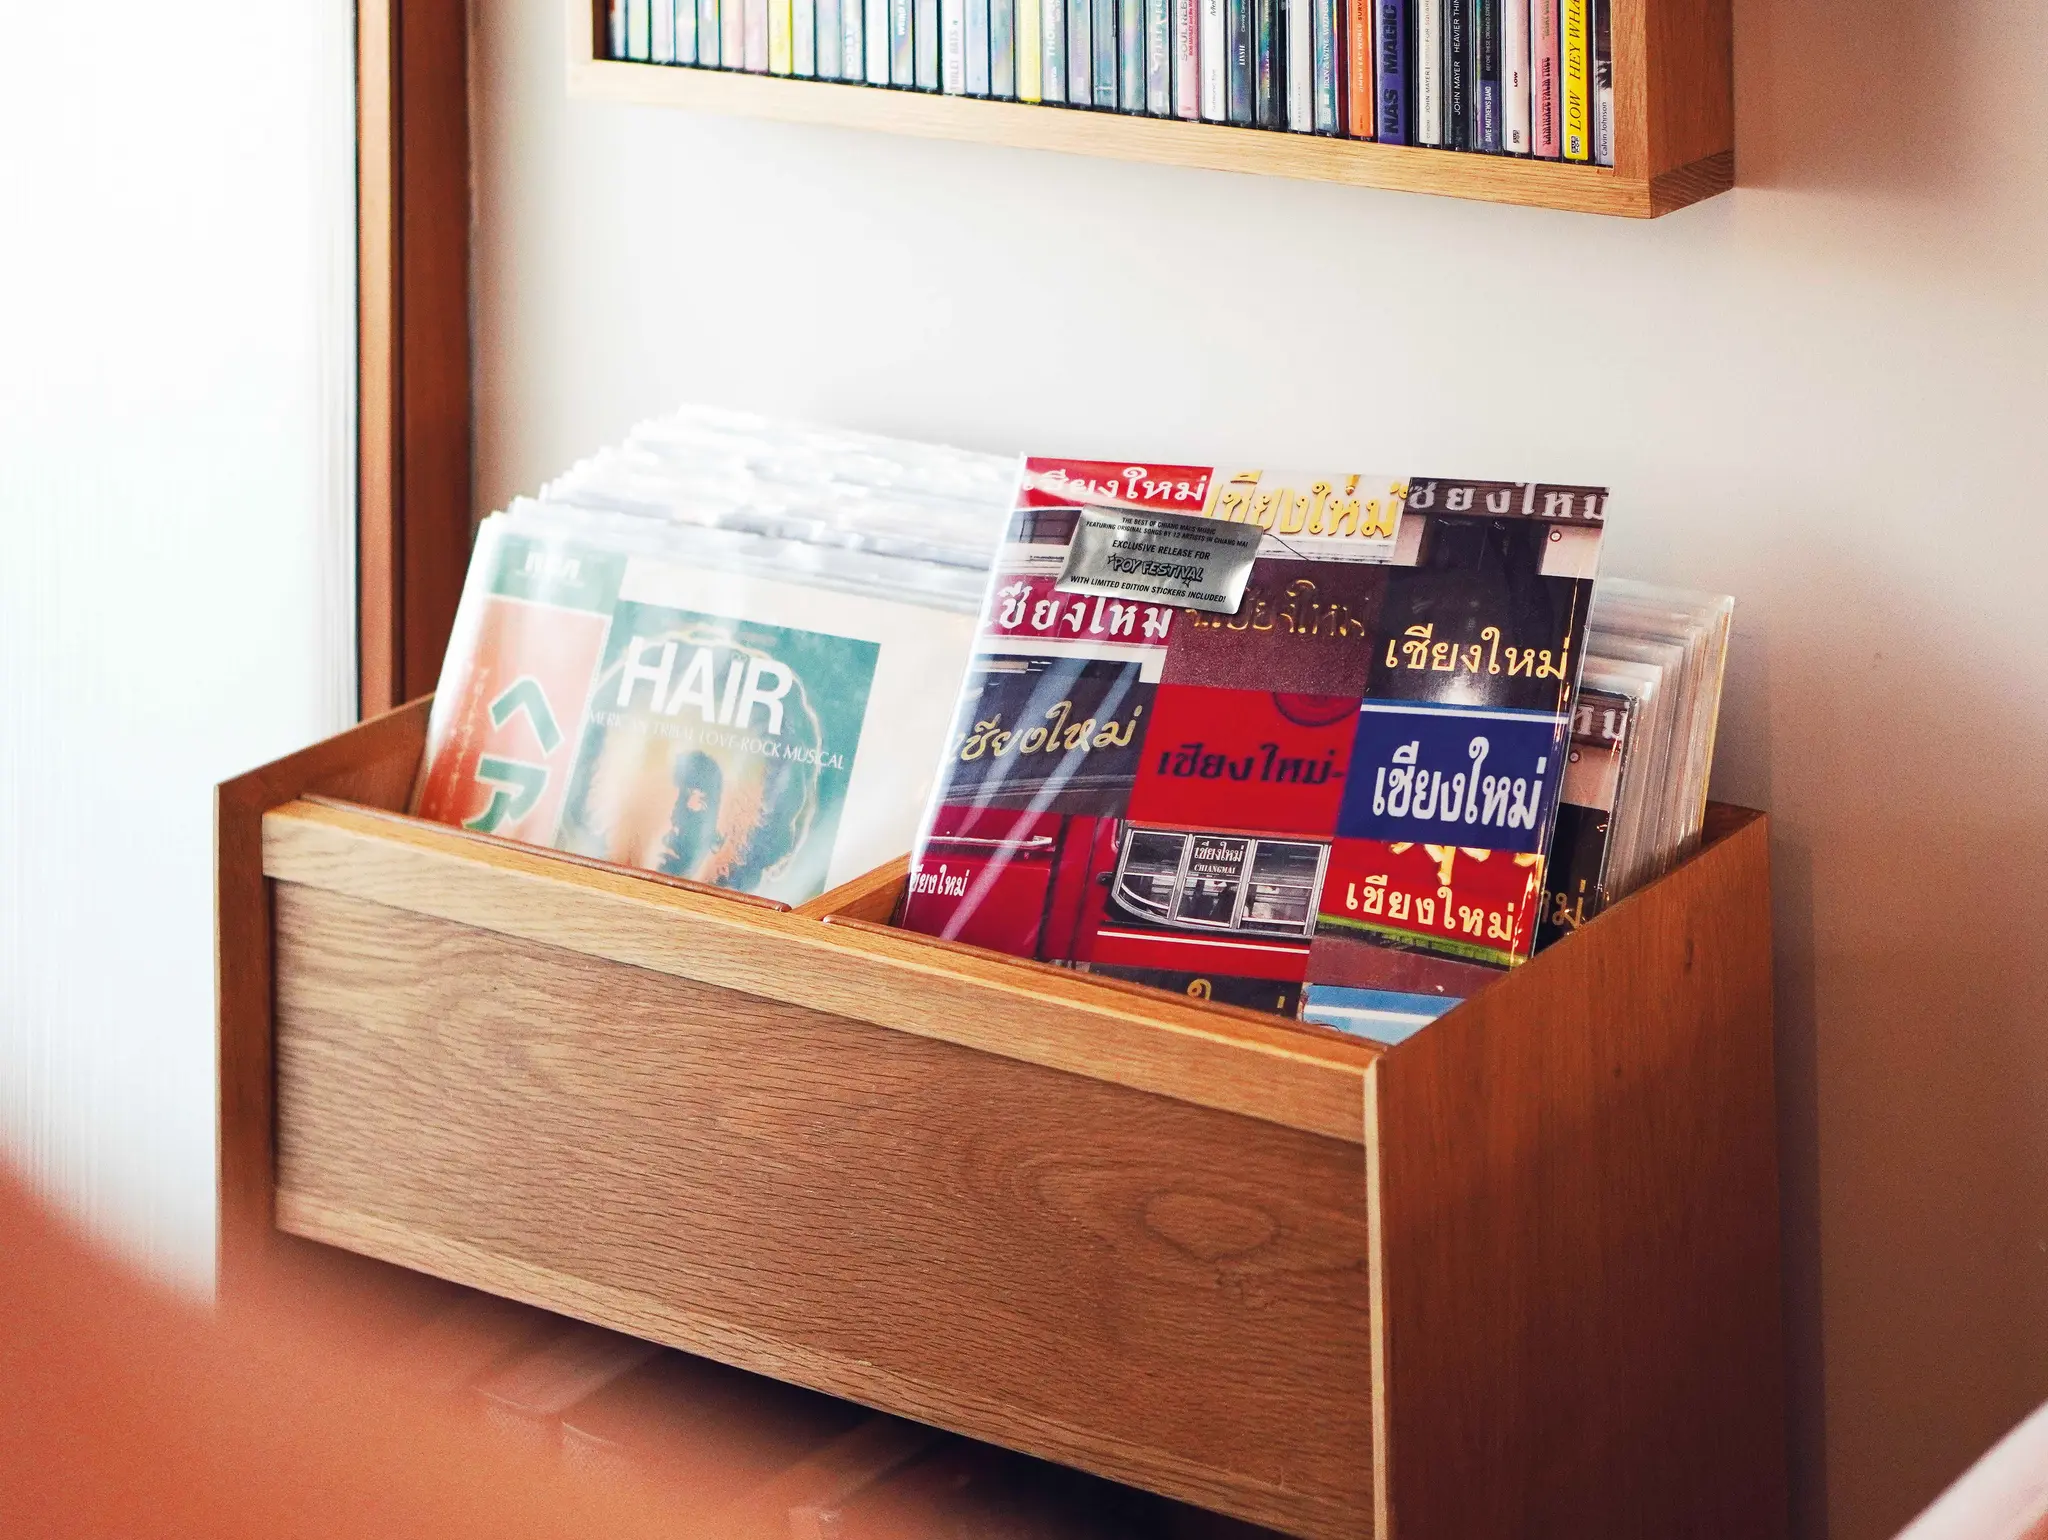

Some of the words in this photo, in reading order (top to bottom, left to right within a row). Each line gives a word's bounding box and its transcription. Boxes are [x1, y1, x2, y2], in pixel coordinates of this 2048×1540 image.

[1180, 28, 1188, 62] SOUL
[1383, 4, 1398, 74] MAGIC
[1542, 57, 1550, 78] TREE
[1569, 42, 1581, 80] HEY
[1453, 92, 1461, 115] JOHN
[1484, 86, 1492, 100] BAND
[1542, 78, 1550, 101] PALM
[1384, 88, 1398, 134] NAS
[1484, 100, 1492, 129] MATTHEWS
[1542, 102, 1551, 146] KAMIKAZE
[1570, 89, 1581, 131] LOW
[1484, 129, 1492, 142] DAVE
[1085, 521, 1116, 530] FEATURING
[1117, 525, 1142, 533] ORIGINAL
[1143, 528, 1162, 536] SONGS
[1181, 532, 1205, 542] ARTISTS
[1214, 536, 1235, 546] CHIANG
[1236, 540, 1249, 548] MAI
[1133, 518, 1149, 526] BEST
[1112, 540, 1156, 553] EXCLUSIVE
[1157, 546, 1193, 558] RELEASE
[1194, 550, 1211, 560] FOR
[1113, 557, 1141, 573] POY
[1142, 560, 1203, 581] FESTIVAL
[1070, 575, 1090, 585] WITH
[1091, 578, 1119, 588] LIMITED
[1120, 582, 1150, 592] EDITION
[1151, 586, 1186, 597] STICKERS
[1188, 591, 1227, 603] INCLUDED!
[1385, 623, 1570, 680] เชียงใหม่
[617, 635, 793, 736] HAIR
[782, 743, 845, 771] MUSICAL
[1372, 736, 1547, 829] เชียงใหม่
[1194, 841, 1244, 862] เชียงใหม่
[1194, 864, 1236, 874] CHIANGMAI
[1346, 874, 1514, 941] เชียงใหม่
